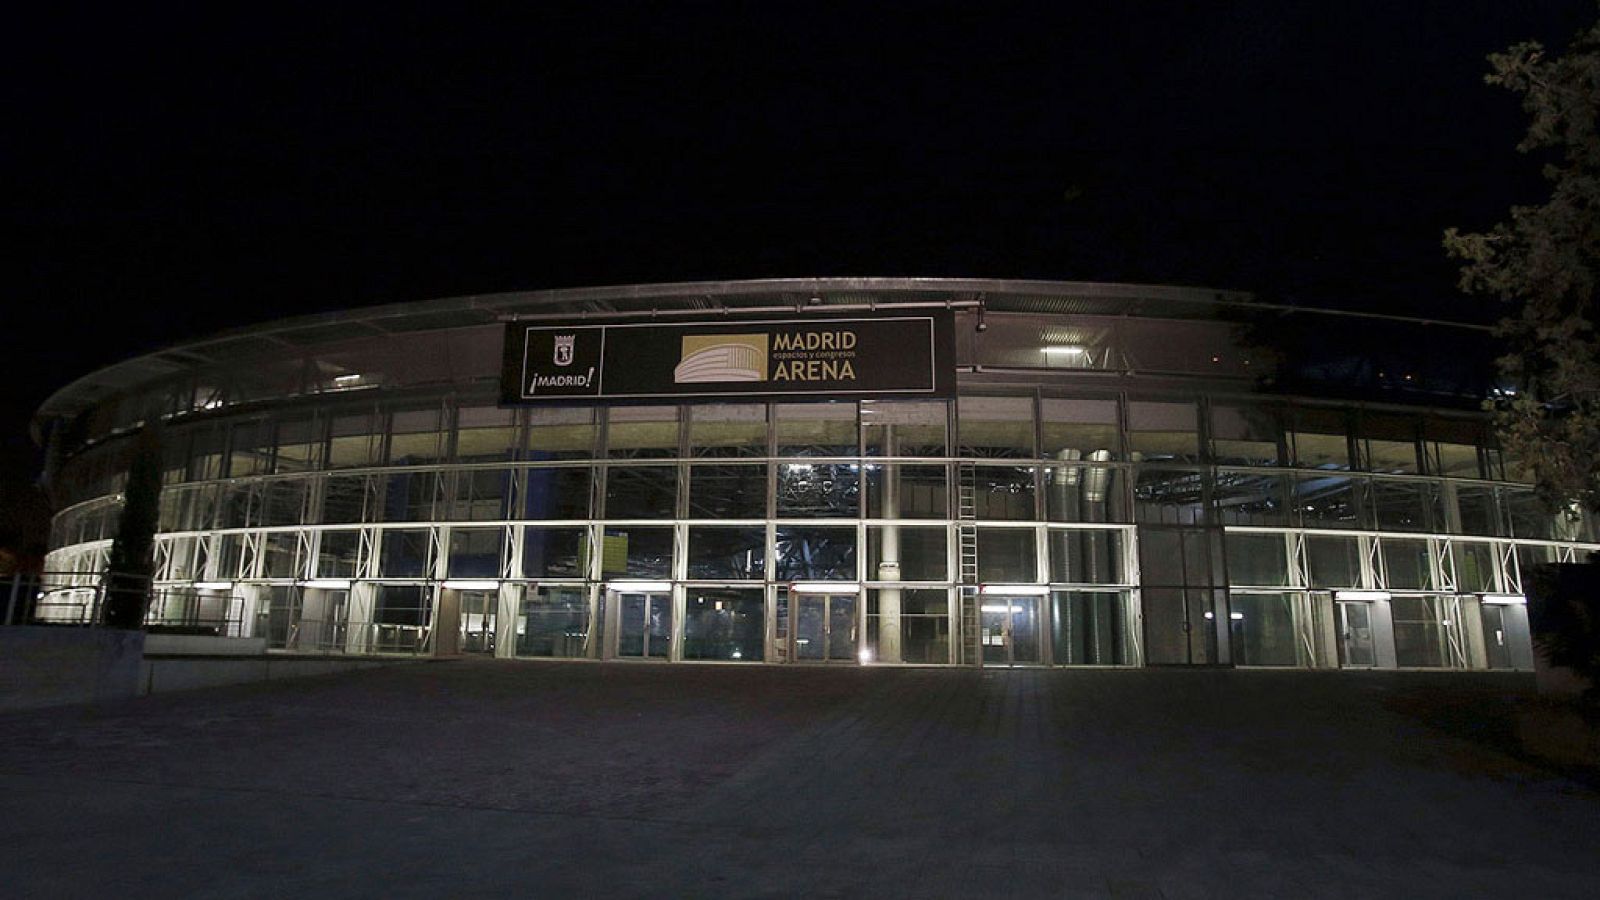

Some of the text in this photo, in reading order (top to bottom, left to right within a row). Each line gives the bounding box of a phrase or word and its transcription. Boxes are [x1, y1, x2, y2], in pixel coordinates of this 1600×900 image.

[773, 332, 857, 350] MADRID
[530, 366, 595, 394] ¡MADRID!
[773, 360, 856, 381] ARENA
